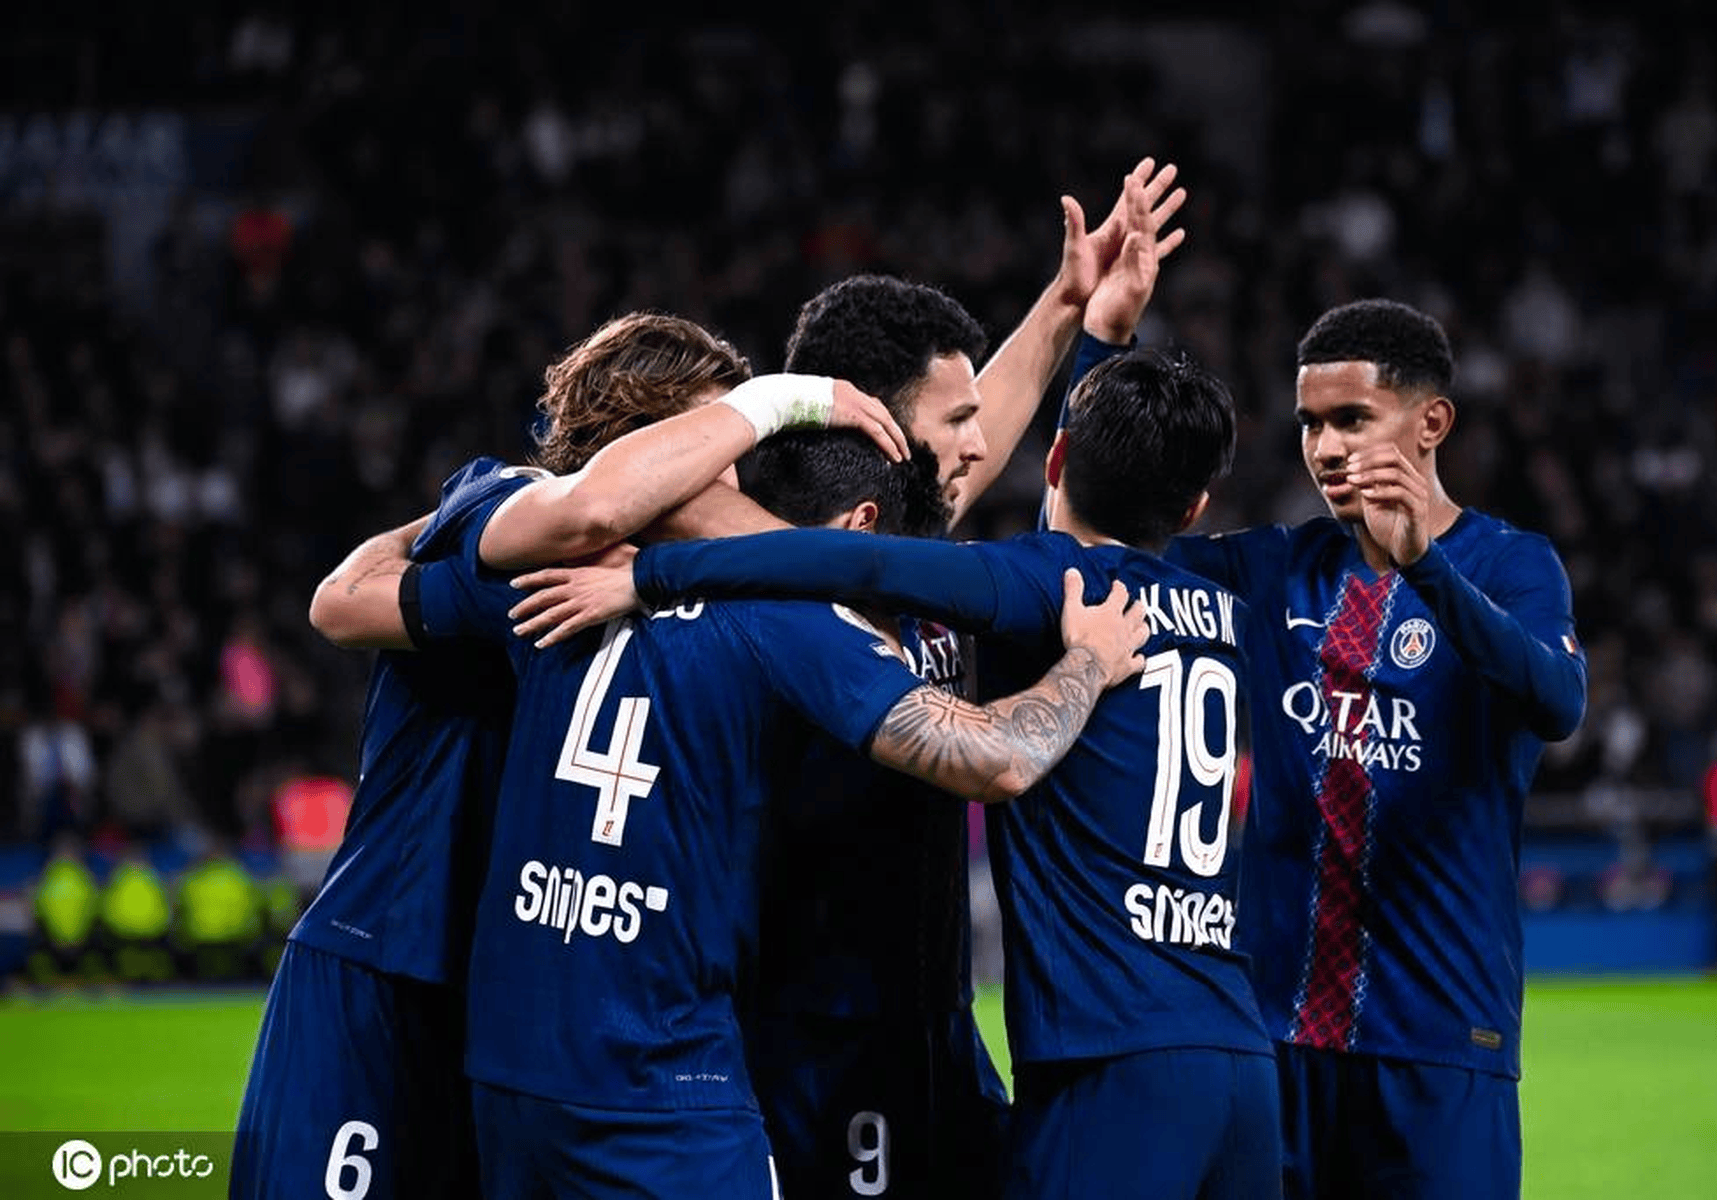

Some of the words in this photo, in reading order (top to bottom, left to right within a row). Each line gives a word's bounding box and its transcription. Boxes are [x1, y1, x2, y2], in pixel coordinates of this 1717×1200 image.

[554, 620, 661, 847] 4
[1139, 649, 1236, 877] 19
[514, 860, 645, 944] snipes
[325, 1121, 379, 1200] 6
[847, 1111, 889, 1196] 9
